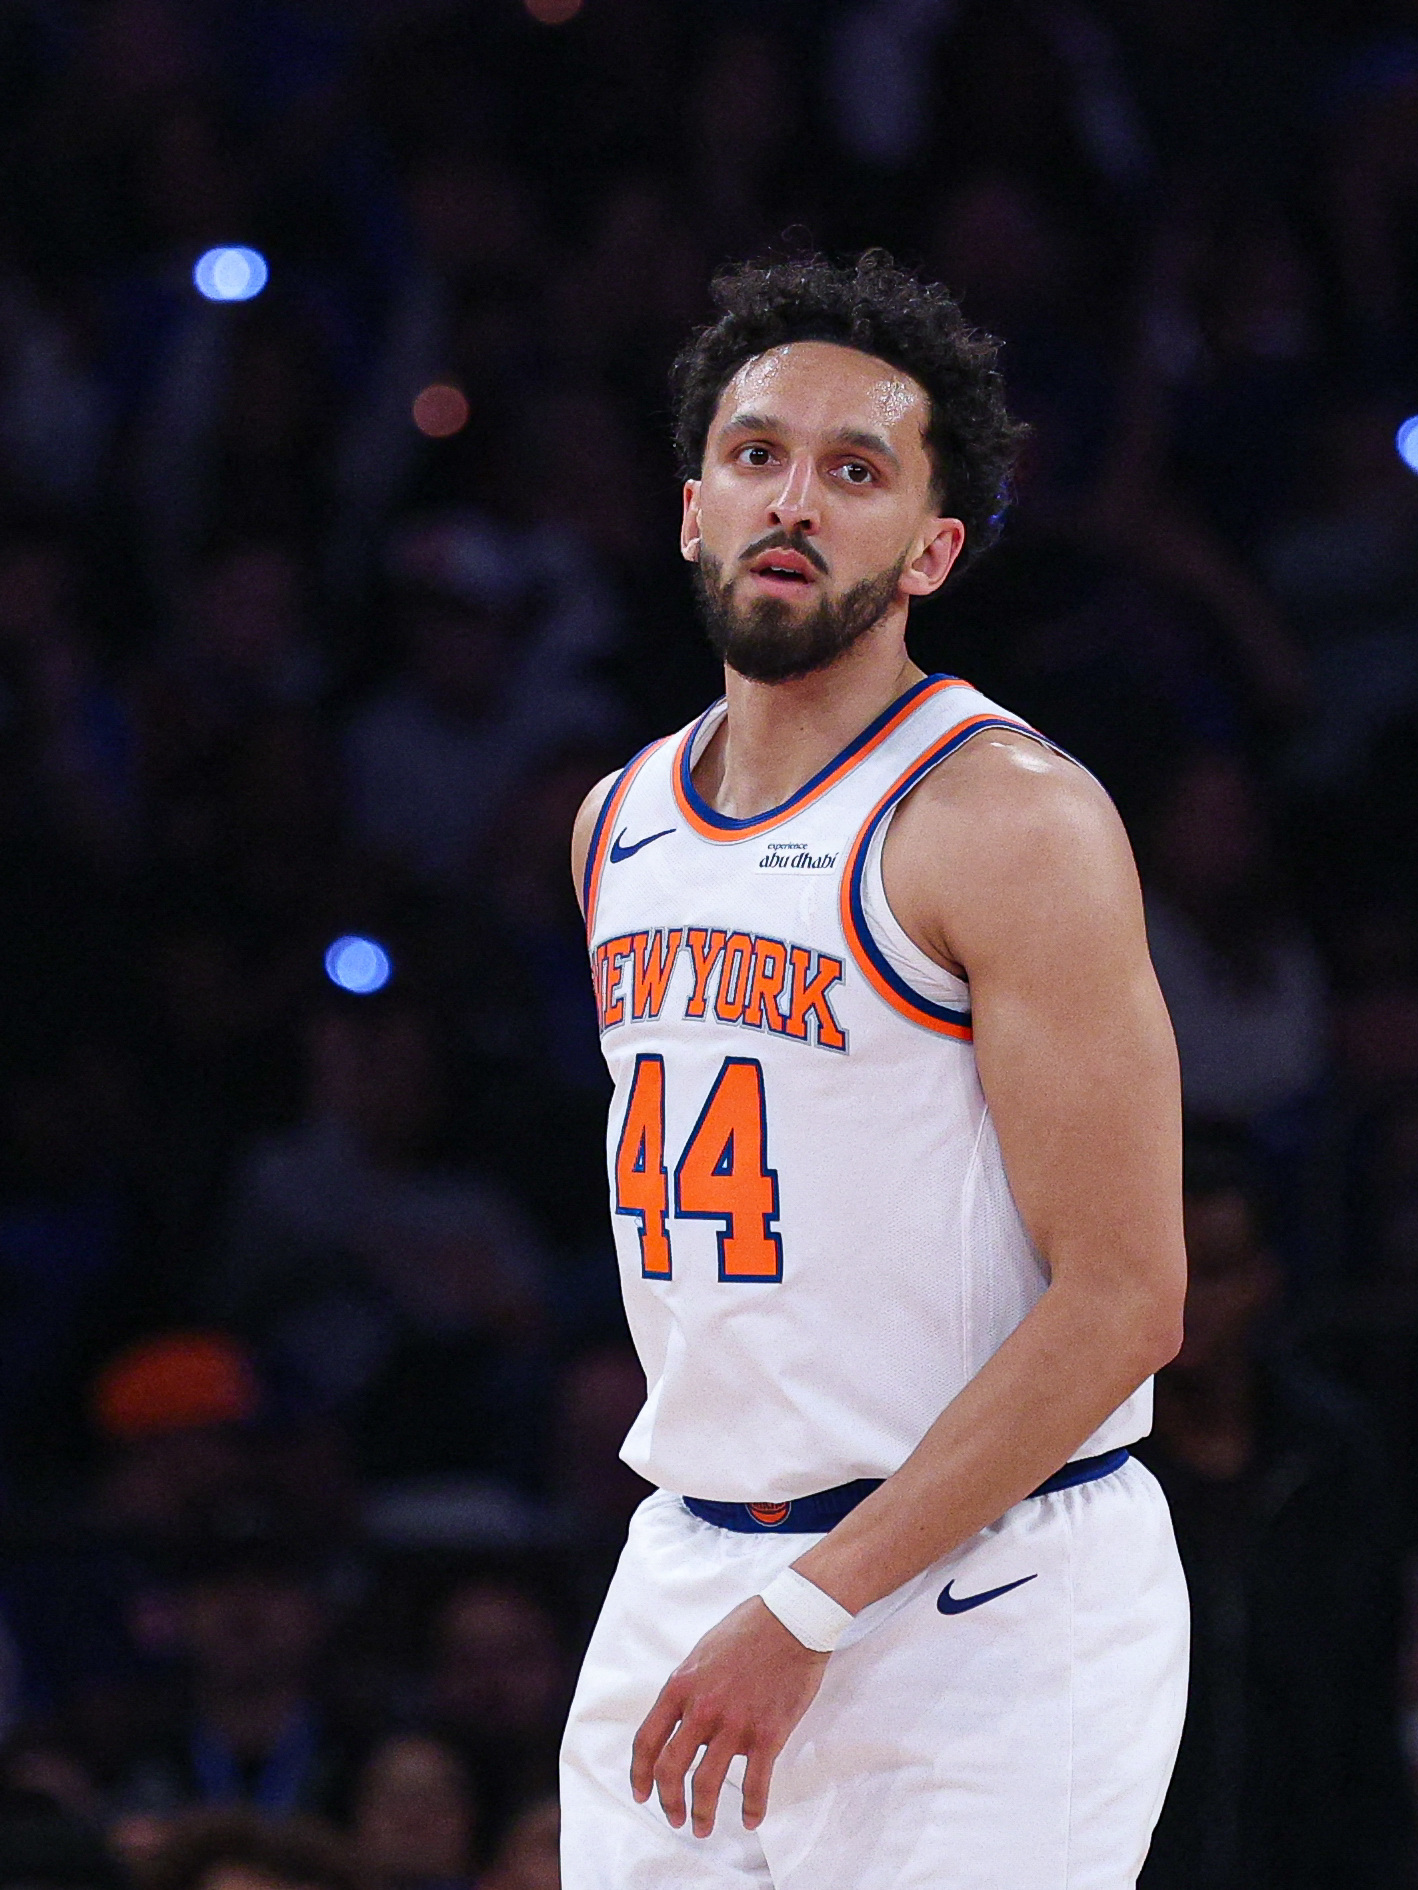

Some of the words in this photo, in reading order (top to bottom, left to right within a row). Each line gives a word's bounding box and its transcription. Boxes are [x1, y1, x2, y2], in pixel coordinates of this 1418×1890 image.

[759, 852, 790, 868] abu
[791, 852, 839, 869] dhabi
[767, 842, 808, 851] experience
[684, 926, 848, 1054] YORK
[616, 1053, 783, 1283] 44
